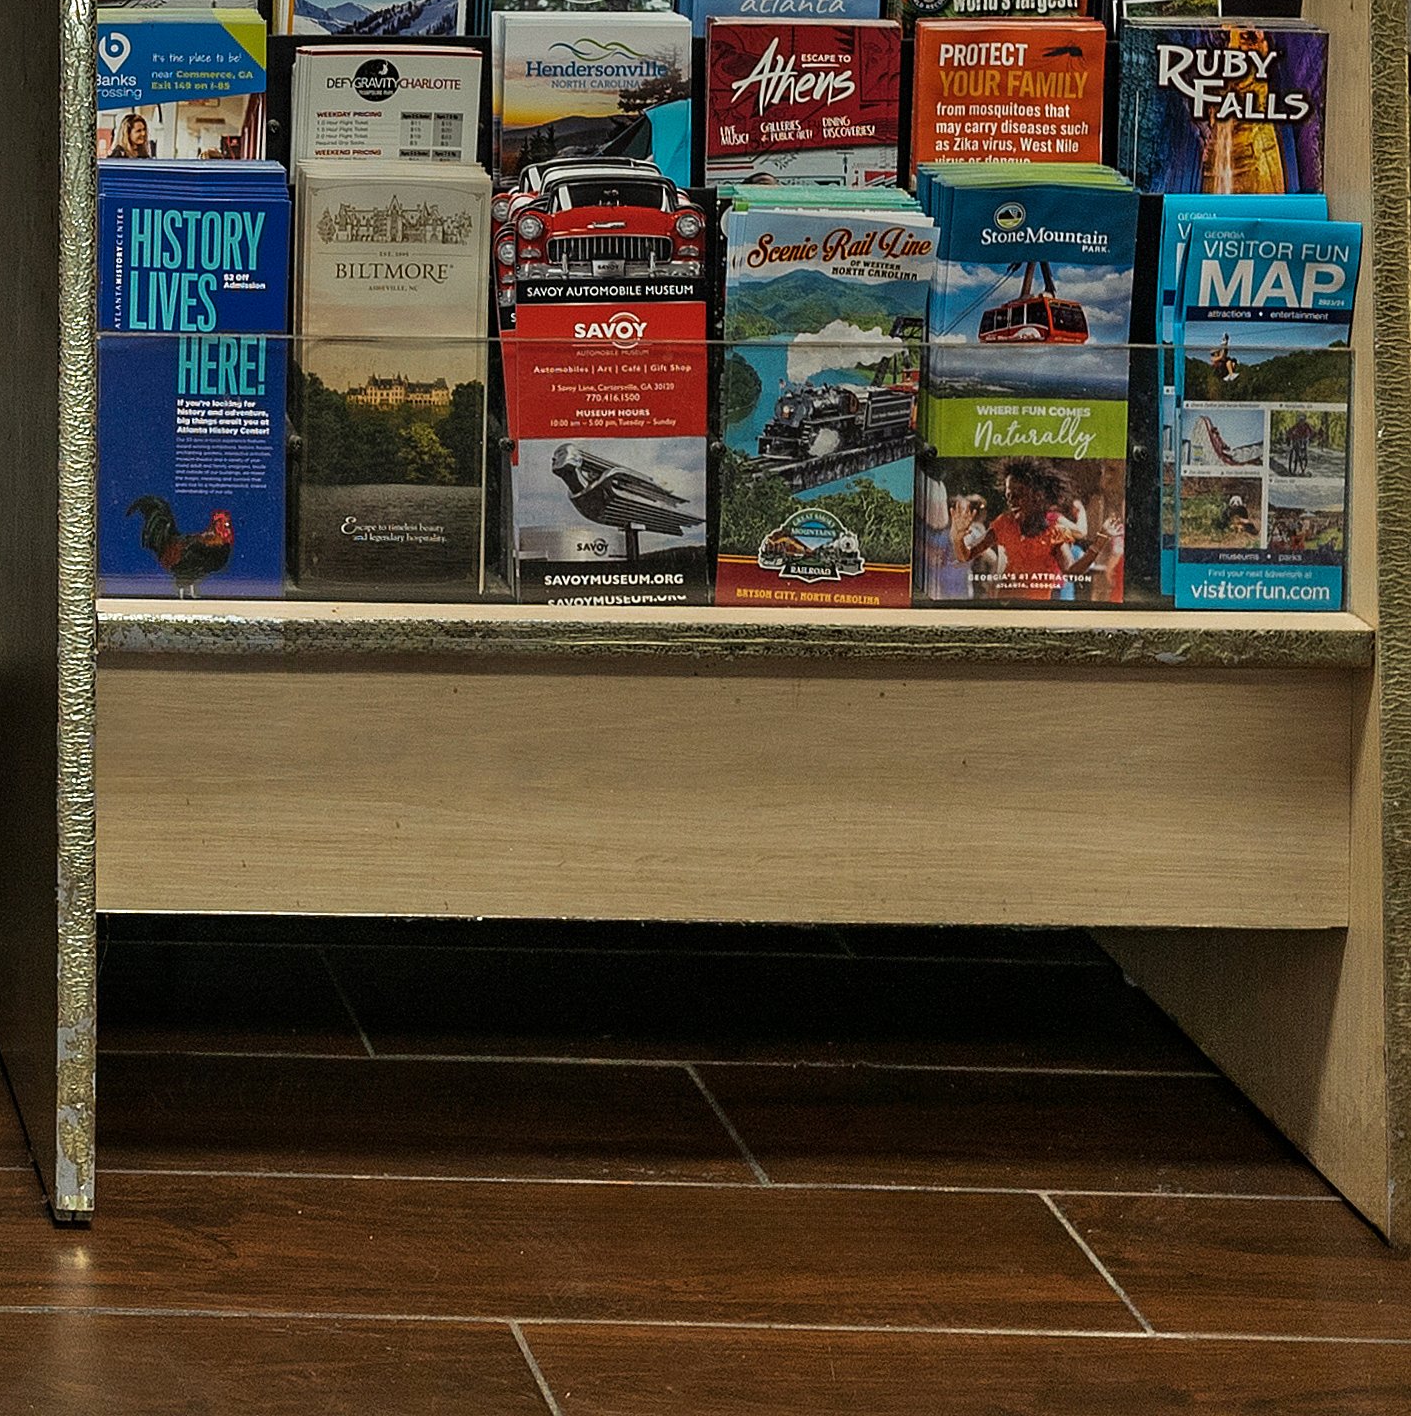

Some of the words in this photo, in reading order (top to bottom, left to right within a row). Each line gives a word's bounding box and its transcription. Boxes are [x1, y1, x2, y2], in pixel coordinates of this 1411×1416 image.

[938, 43, 1028, 67] PROTECT
[526, 60, 668, 78] Hendersonville
[1157, 44, 1277, 86] RUBY
[939, 71, 1004, 96] YOUR
[1008, 71, 1088, 100] FAMILY
[1193, 79, 1310, 120] FALLS
[936, 104, 965, 116] from
[969, 103, 1042, 119] mosquitoes
[1044, 104, 1070, 116] that
[936, 122, 962, 136] may
[965, 122, 998, 136] carry
[1001, 119, 1056, 134] diseases
[1059, 121, 1088, 135] such
[935, 141, 950, 152] as
[953, 137, 979, 152] Zika
[982, 138, 1016, 154] virus,
[1020, 138, 1050, 152] West
[1053, 139, 1079, 153] Nile
[130, 208, 266, 271] HISTORY
[747, 234, 818, 268] Scenic
[823, 228, 875, 261] Rail
[878, 228, 932, 259] Line
[1204, 241, 1292, 259] VISITOR
[1301, 244, 1349, 263] FUN
[335, 263, 450, 283] BILTMORE
[526, 286, 564, 298] SAVOY
[566, 285, 642, 297] AUTOMOBILE
[645, 284, 694, 296] MUSEUM
[1197, 259, 1346, 308] MAP
[129, 271, 218, 332] LIVES
[1207, 310, 1252, 319] attractions
[1270, 310, 1329, 321] entertainment
[574, 321, 647, 339] SAVOY
[178, 336, 266, 396] HERE!
[976, 405, 1018, 417] WHERE
[1022, 405, 1045, 417] FUN
[1048, 406, 1091, 417] COMES
[974, 415, 1096, 460] Naturally
[1279, 554, 1302, 562] parks
[544, 574, 683, 585] SAVOYMUSEUM.ORG
[736, 588, 773, 600] BRYSON
[775, 589, 798, 602] CITY,
[800, 592, 830, 604] NORTH
[833, 594, 880, 606] CAROLINA
[1191, 581, 1330, 600] visitorfun.com
